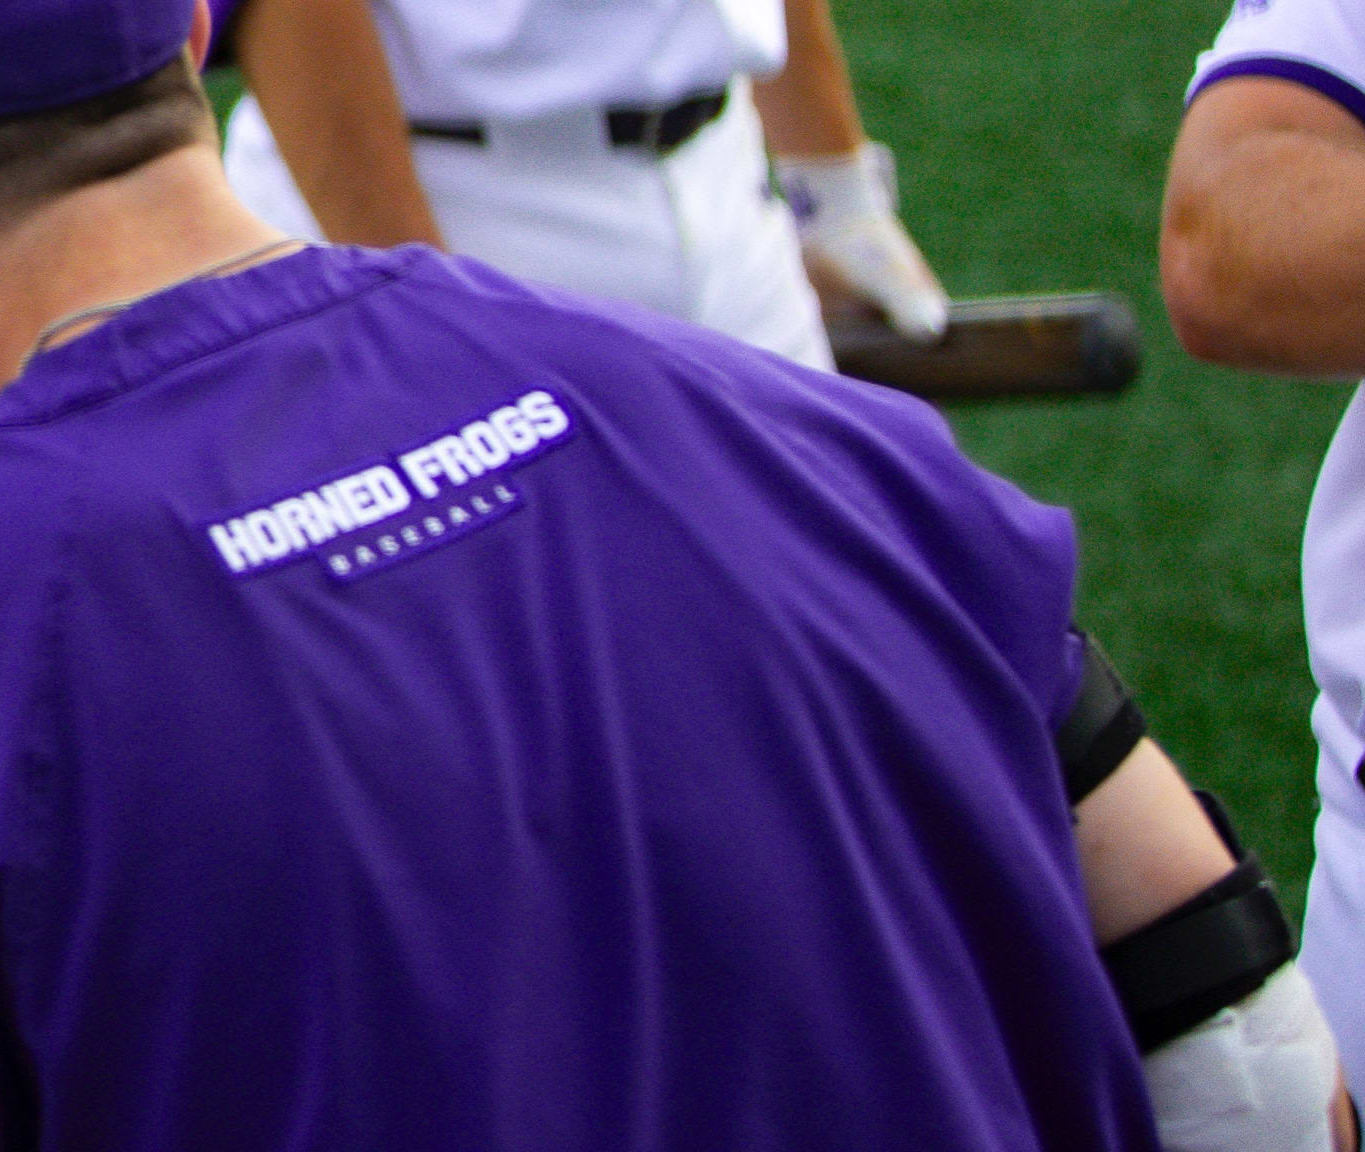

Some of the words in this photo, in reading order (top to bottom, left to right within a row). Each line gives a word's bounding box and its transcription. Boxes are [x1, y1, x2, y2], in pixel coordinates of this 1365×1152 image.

[208, 464, 411, 573] HORNED
[398, 390, 570, 499] FROGS
[327, 483, 517, 576] BASEBALL
